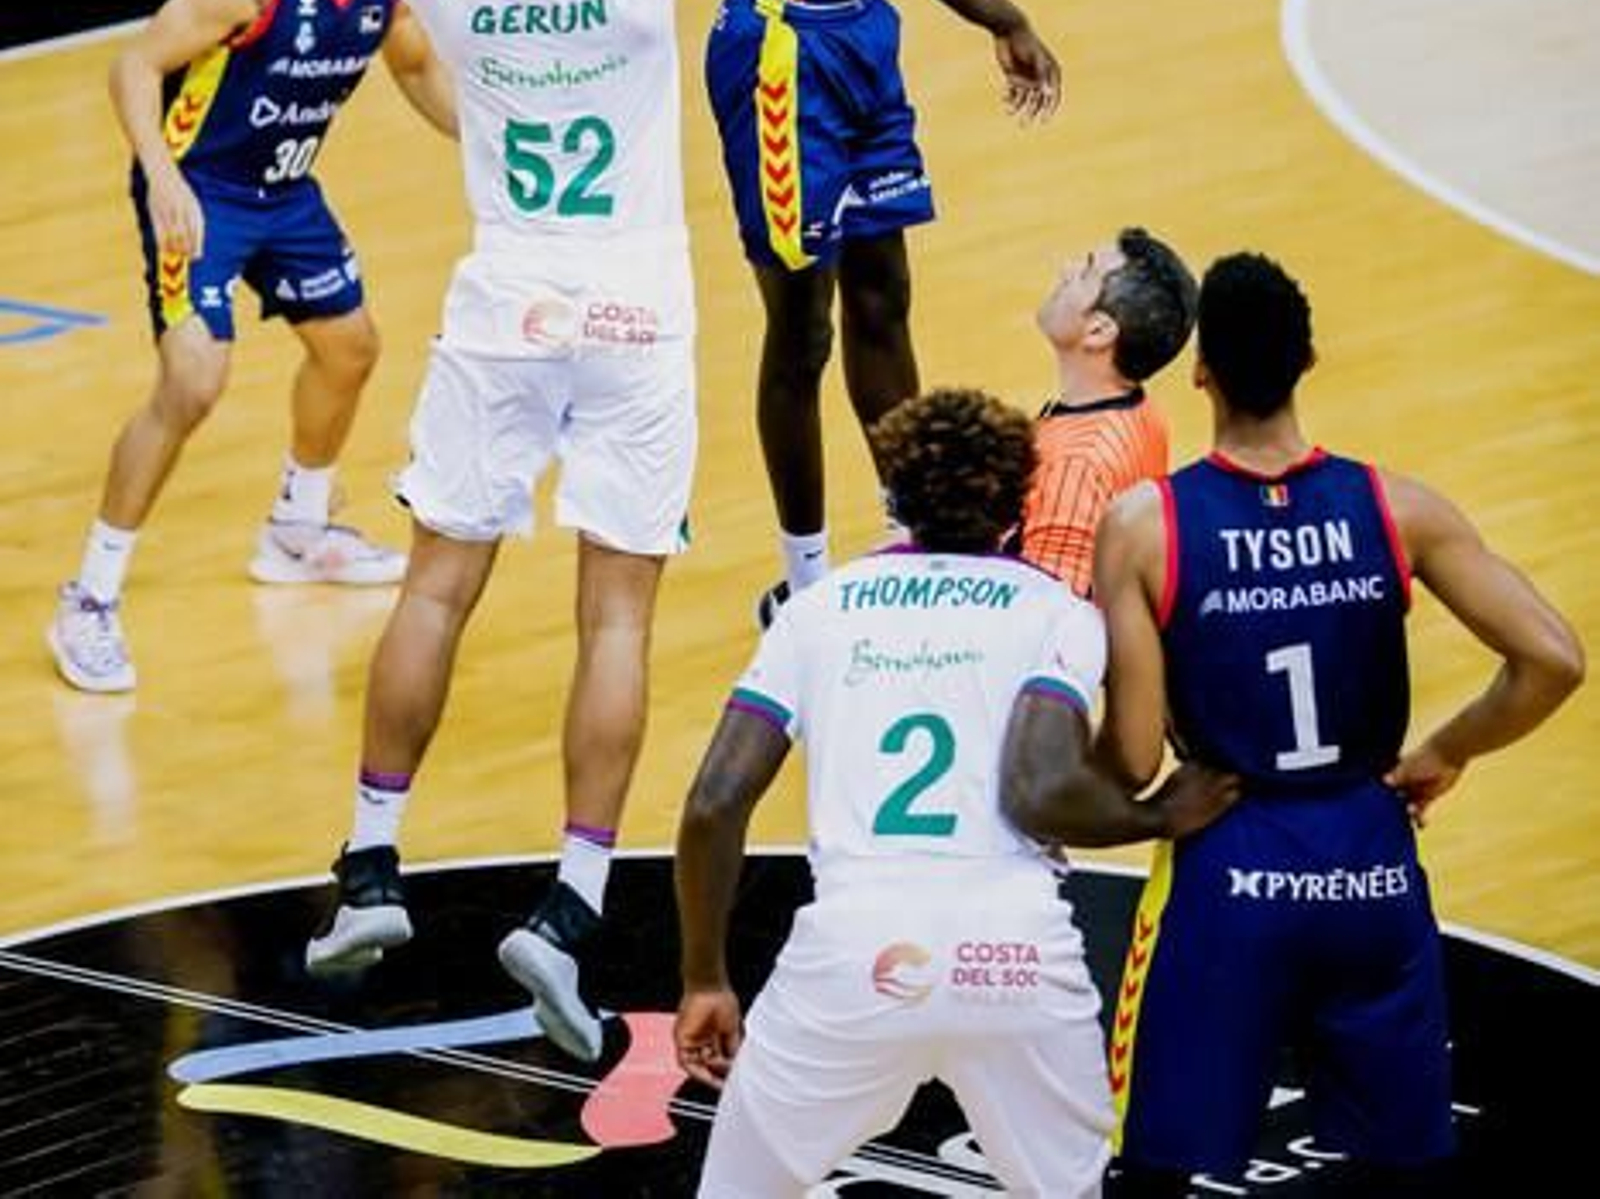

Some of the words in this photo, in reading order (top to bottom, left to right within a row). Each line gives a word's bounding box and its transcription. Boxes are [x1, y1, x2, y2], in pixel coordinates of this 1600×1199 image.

[264, 135, 319, 183] 30
[504, 114, 614, 217] 52
[1218, 519, 1354, 572] TYSON
[839, 575, 1021, 610] THOMPSON
[1226, 574, 1385, 613] MORABANC
[1265, 642, 1341, 771] 1
[872, 713, 958, 835] 2
[952, 968, 996, 987] DEL
[957, 943, 1041, 964] COSTA
